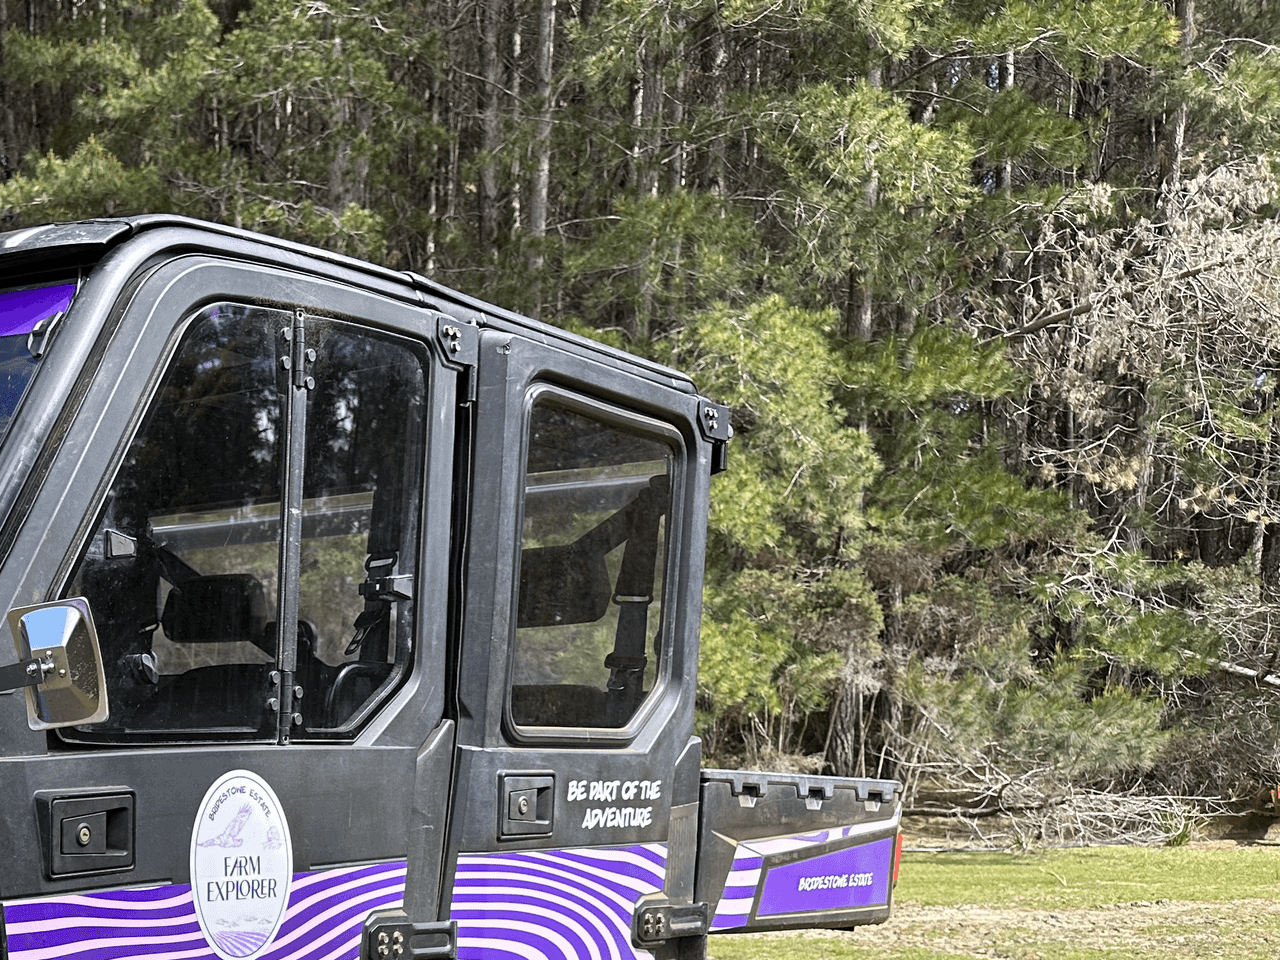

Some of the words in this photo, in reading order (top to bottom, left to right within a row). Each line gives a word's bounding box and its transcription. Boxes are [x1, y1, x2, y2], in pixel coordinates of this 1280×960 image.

[567, 780, 587, 802] BE
[588, 780, 620, 802] PART
[621, 780, 639, 800] OF
[638, 779, 662, 800] THE
[208, 785, 247, 822] BRIDESTOWE
[249, 788, 272, 818] ESTATE
[581, 806, 653, 830] ADVENTURE
[224, 855, 261, 877] FARM
[207, 878, 277, 902] EXPLORER
[798, 873, 850, 892] BRIDESTOWE
[848, 872, 874, 887] ESTATE
